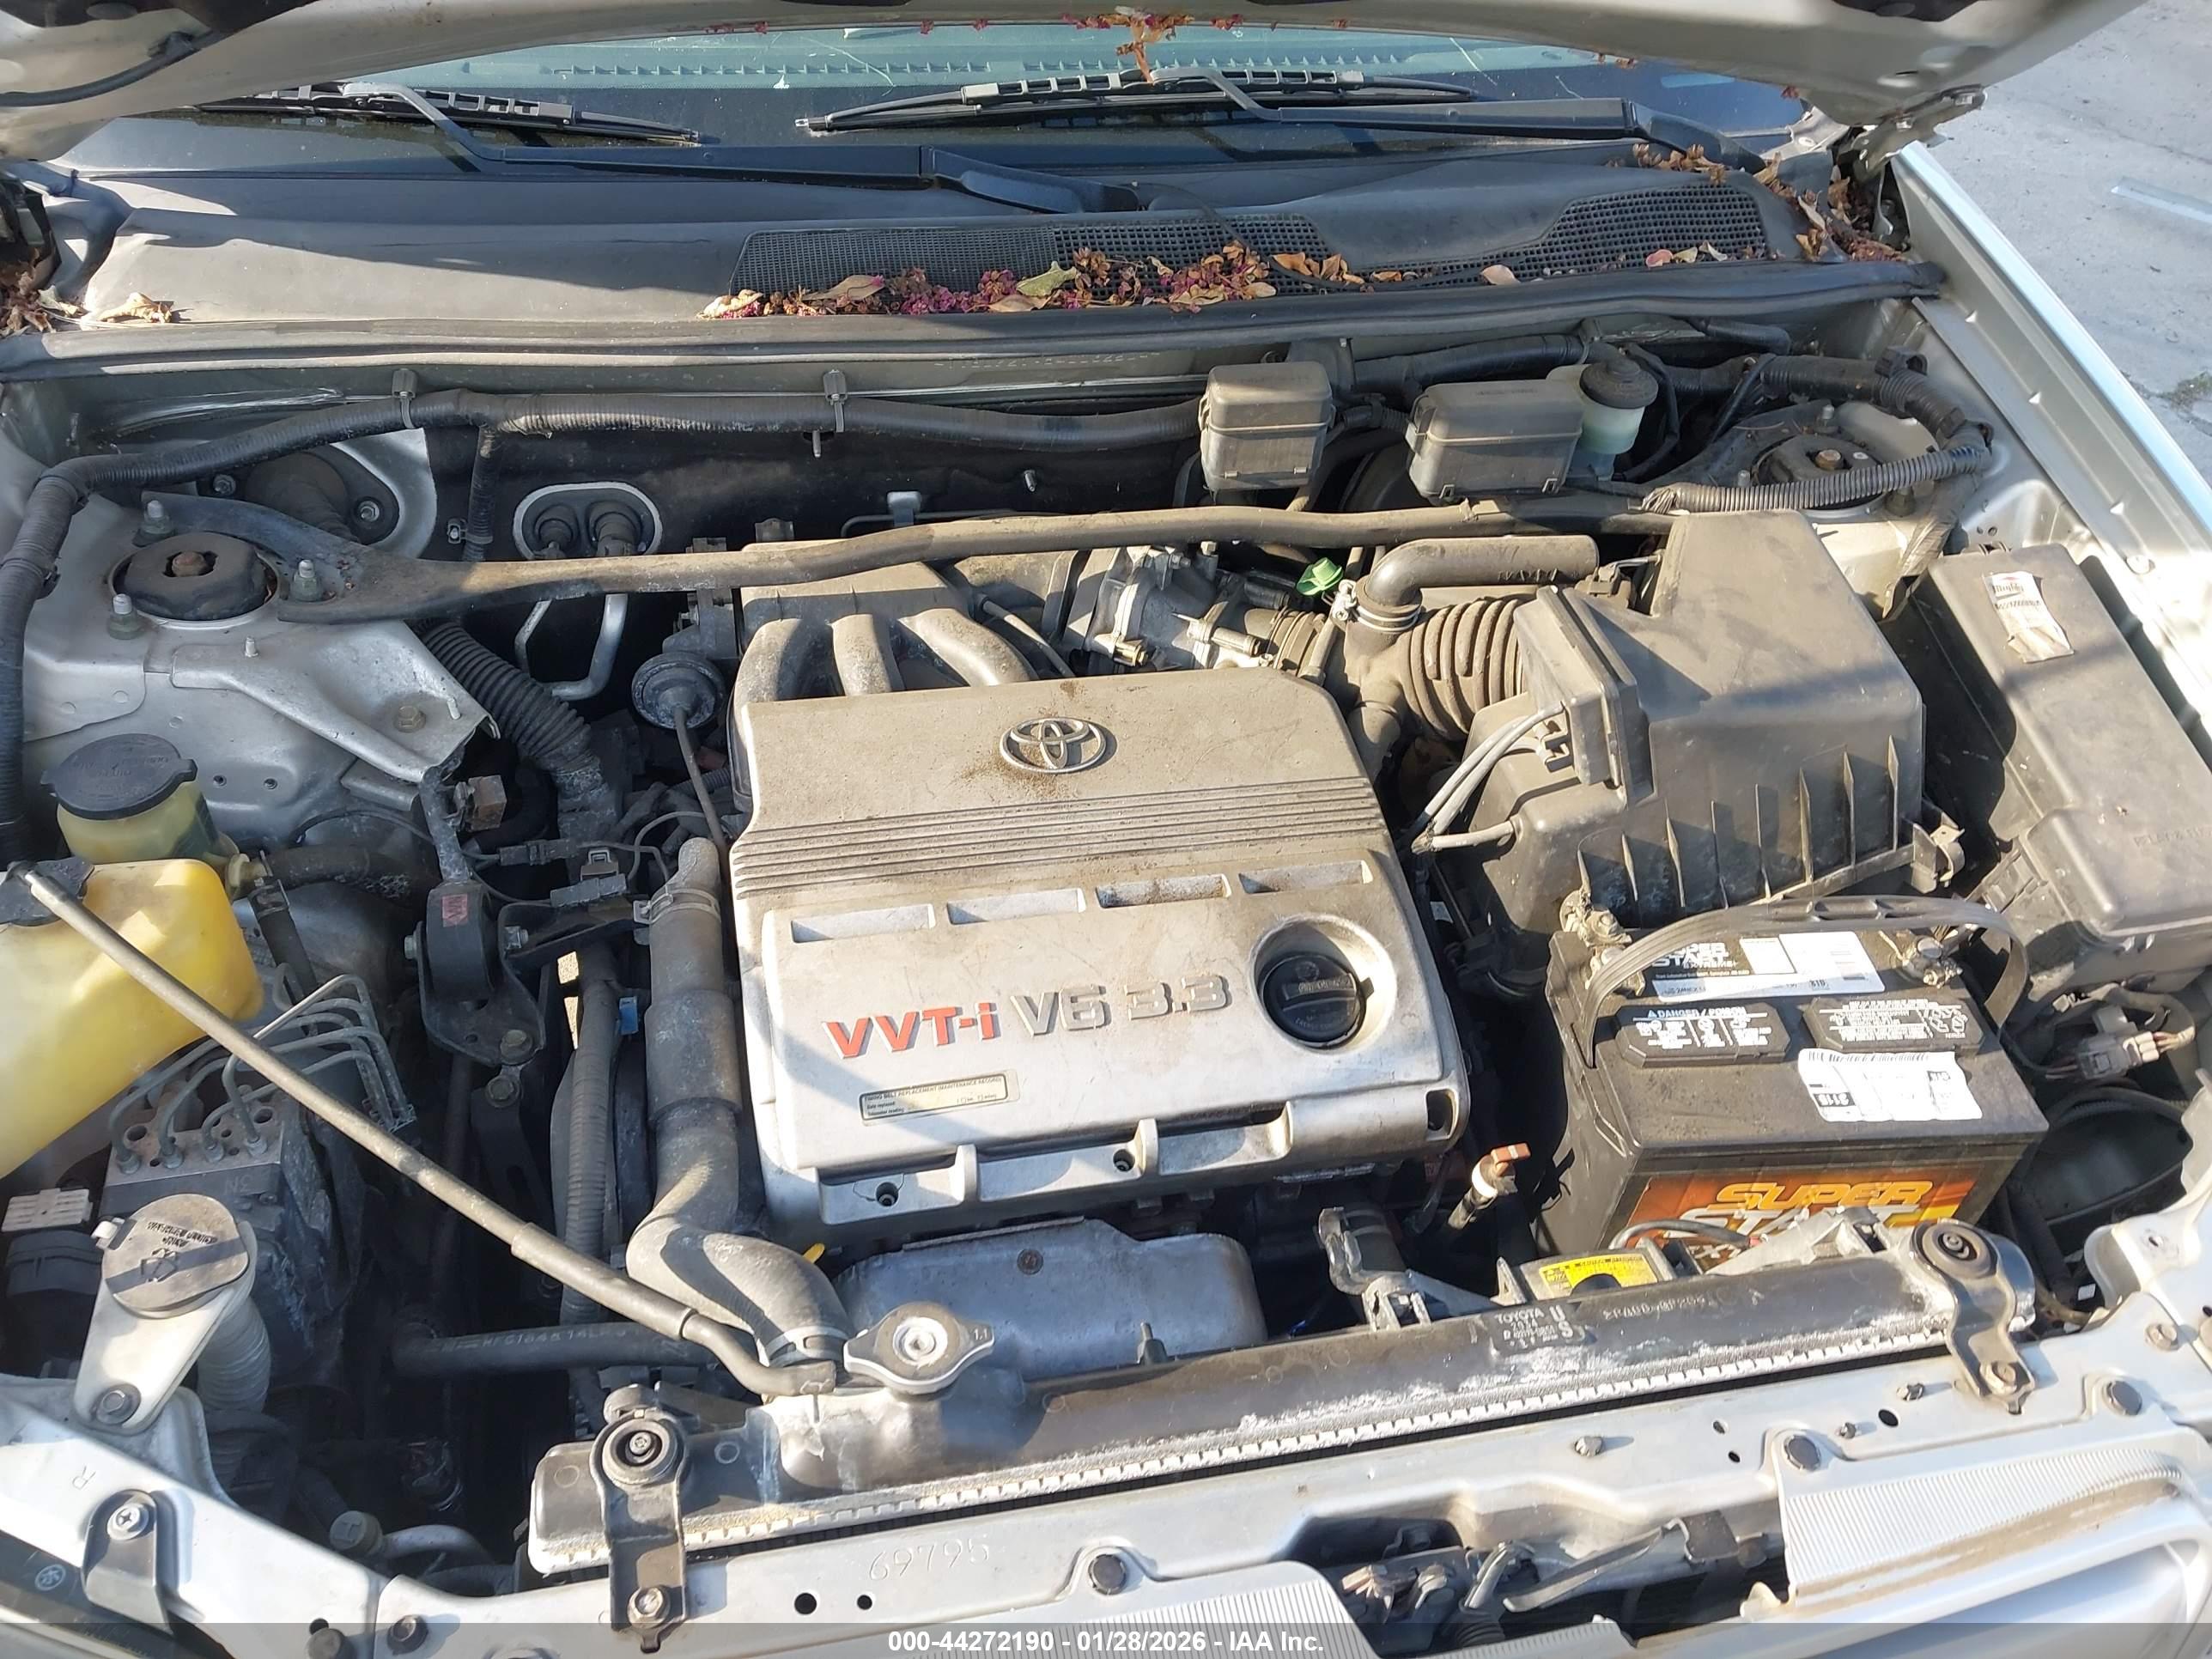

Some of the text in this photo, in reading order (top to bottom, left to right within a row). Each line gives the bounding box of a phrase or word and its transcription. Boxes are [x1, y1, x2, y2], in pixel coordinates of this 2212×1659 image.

[823, 975, 1231, 1060] VVT-i V6 3.3
[1716, 1182, 1934, 1210] SUPER
[1494, 1307, 1545, 1325] TOYOTA
[869, 1538, 988, 1581] 69795
